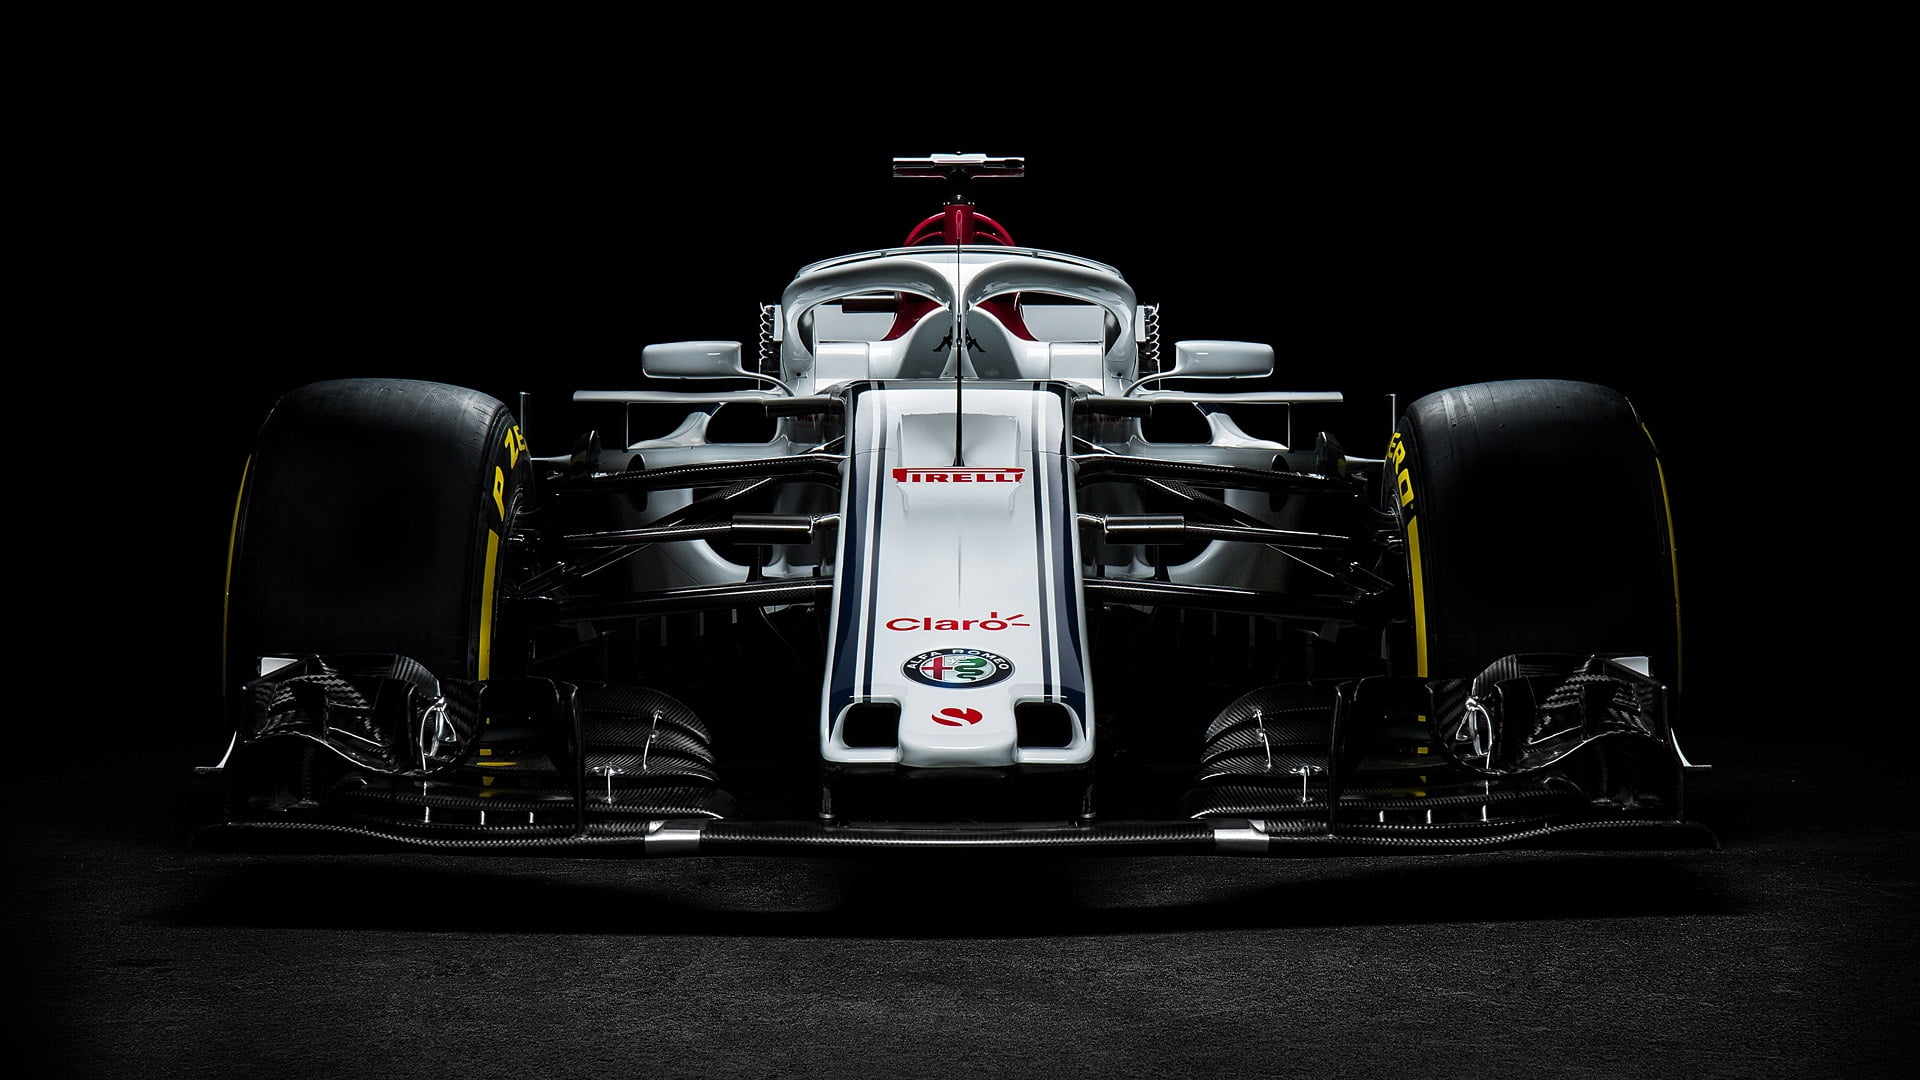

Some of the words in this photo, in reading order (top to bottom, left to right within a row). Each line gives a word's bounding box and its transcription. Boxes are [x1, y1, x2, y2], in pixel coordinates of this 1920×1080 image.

[892, 468, 1026, 483] PIRELLI
[886, 612, 1030, 631] Claro
[906, 651, 943, 670] ALFA
[951, 649, 1010, 670] ROMEO
